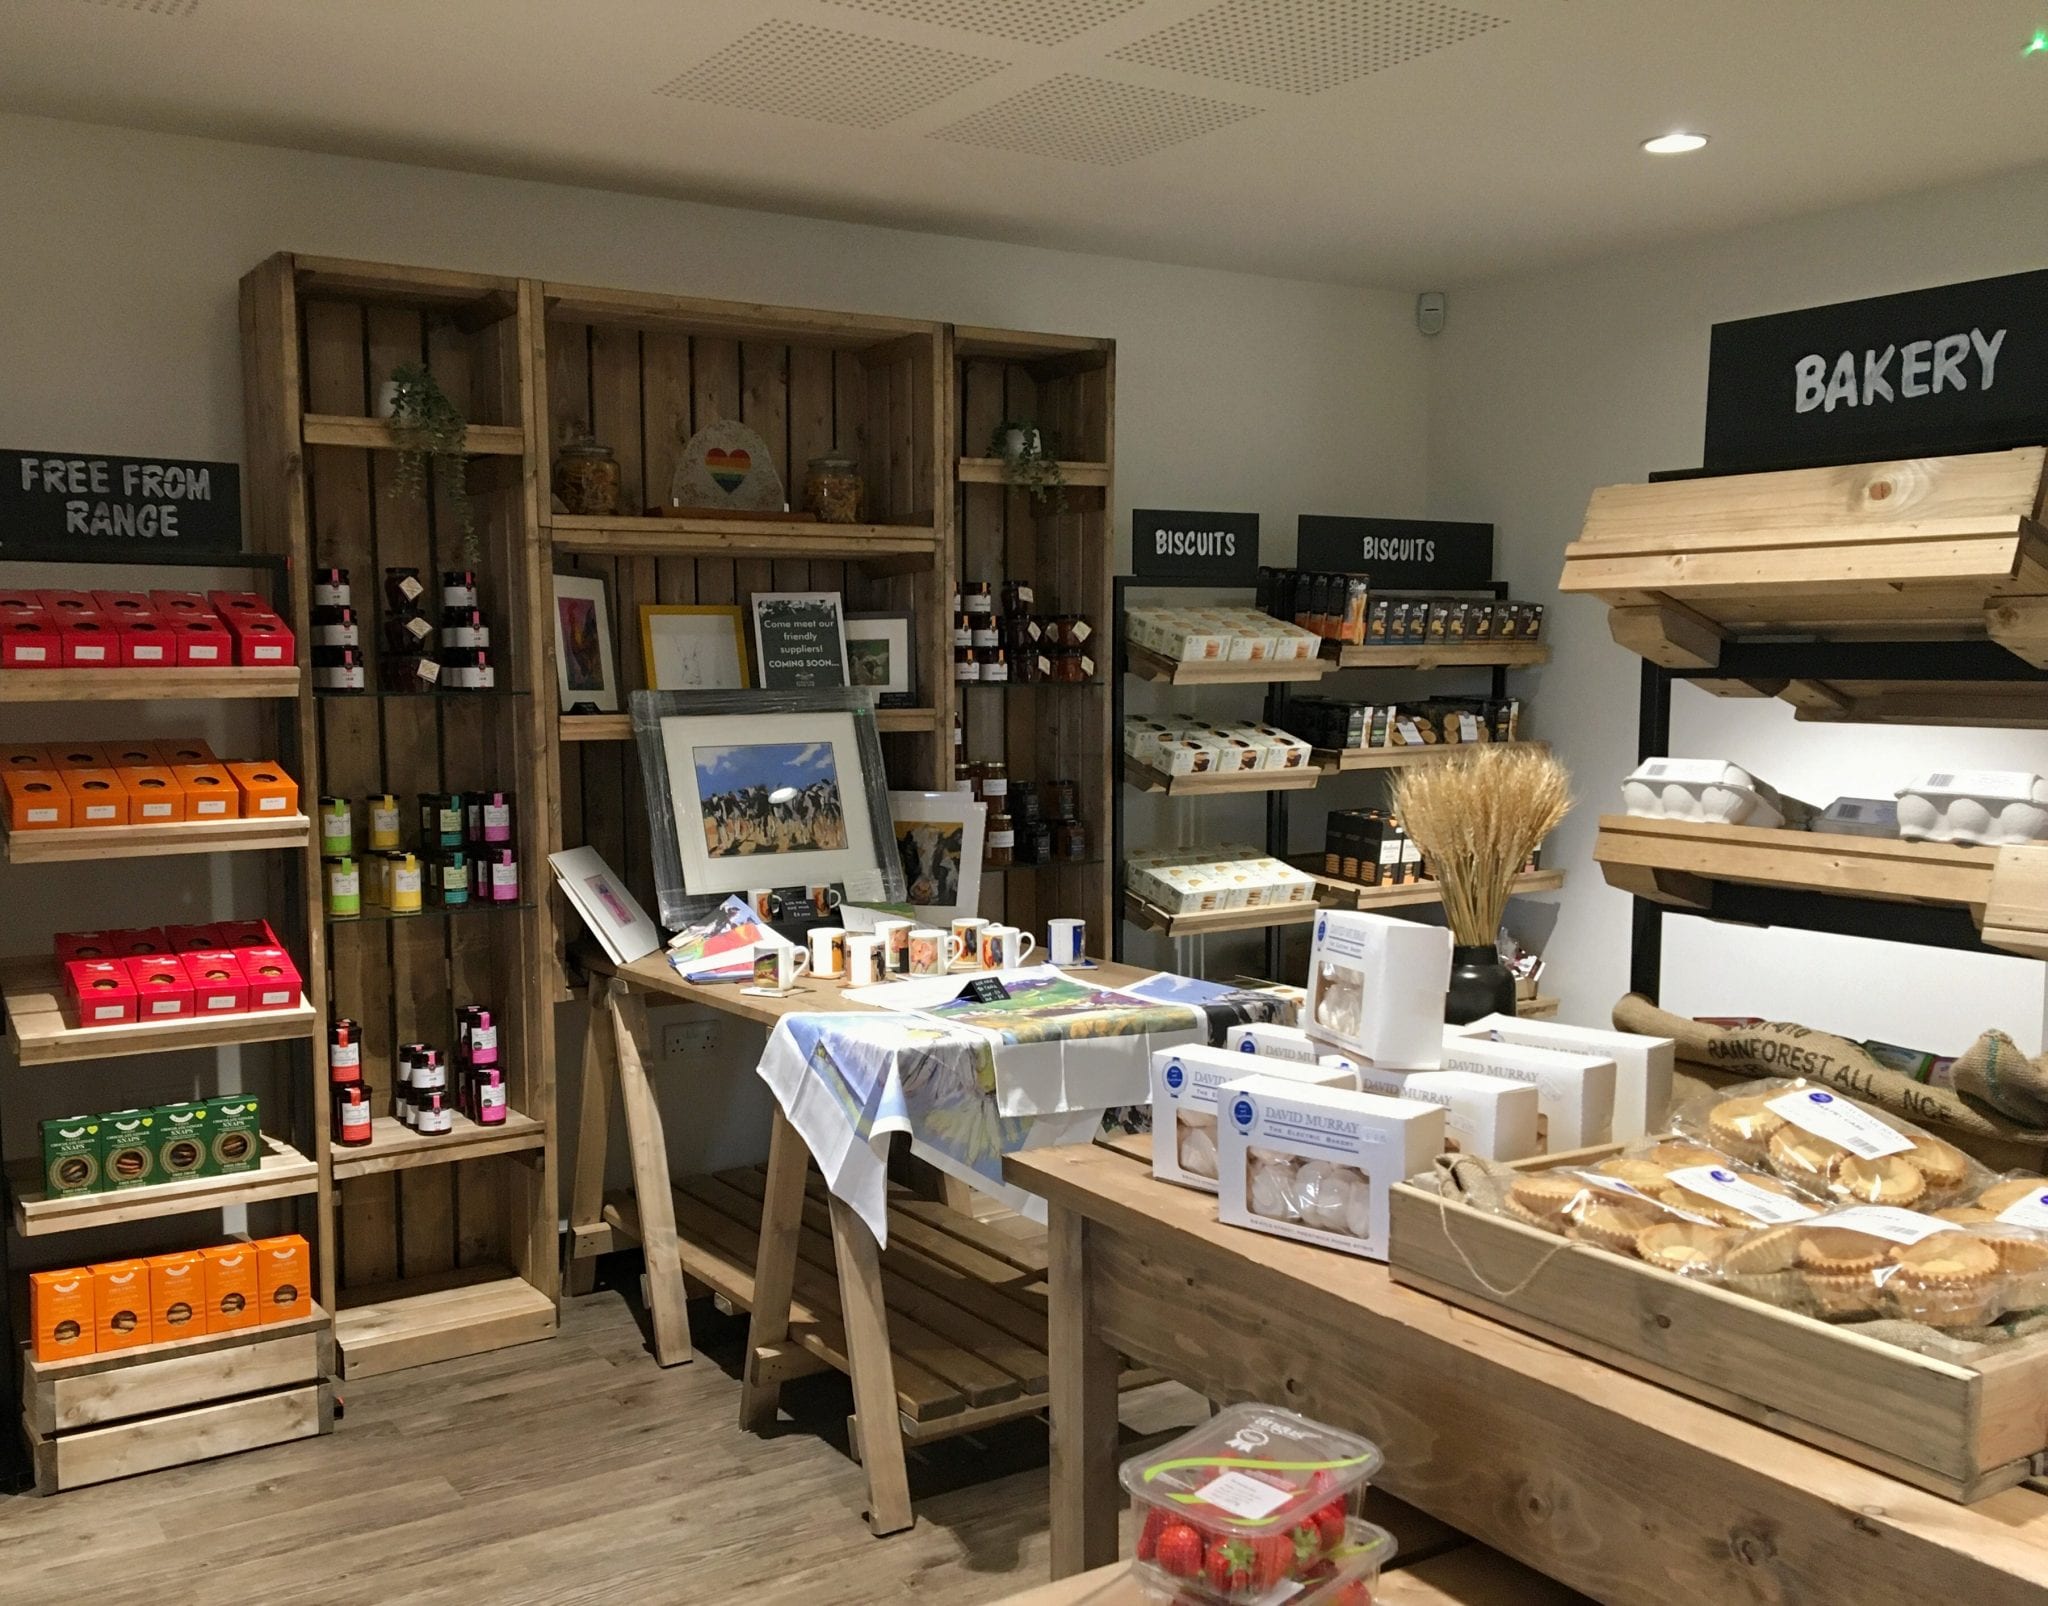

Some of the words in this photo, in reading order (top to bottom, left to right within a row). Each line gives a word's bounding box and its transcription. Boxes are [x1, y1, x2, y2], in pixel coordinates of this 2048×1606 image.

[1795, 327, 2007, 413] BAKERY
[20, 458, 110, 493] FREE
[122, 464, 211, 500] FROM
[66, 500, 179, 537] RANGE
[1155, 529, 1235, 557] BISCUITS
[1363, 536, 1435, 562] BISCUITS
[763, 620, 791, 628] Come
[794, 620, 816, 628] meet
[783, 632, 818, 642] friendly
[780, 645, 824, 655] suppliers!
[768, 660, 804, 668] COMING
[1265, 1045, 1297, 1059] DAVID
[1707, 1039, 1835, 1076] RAINFOREST
[1194, 1071, 1227, 1086] DAVID
[1448, 1059, 1485, 1075] DAVID
[1486, 1065, 1539, 1082] MURRAY
[1363, 1078, 1400, 1095] DAVID
[1401, 1085, 1453, 1106] MURRAY
[1265, 1107, 1304, 1123] DAVID
[1305, 1114, 1360, 1134] MURRAY
